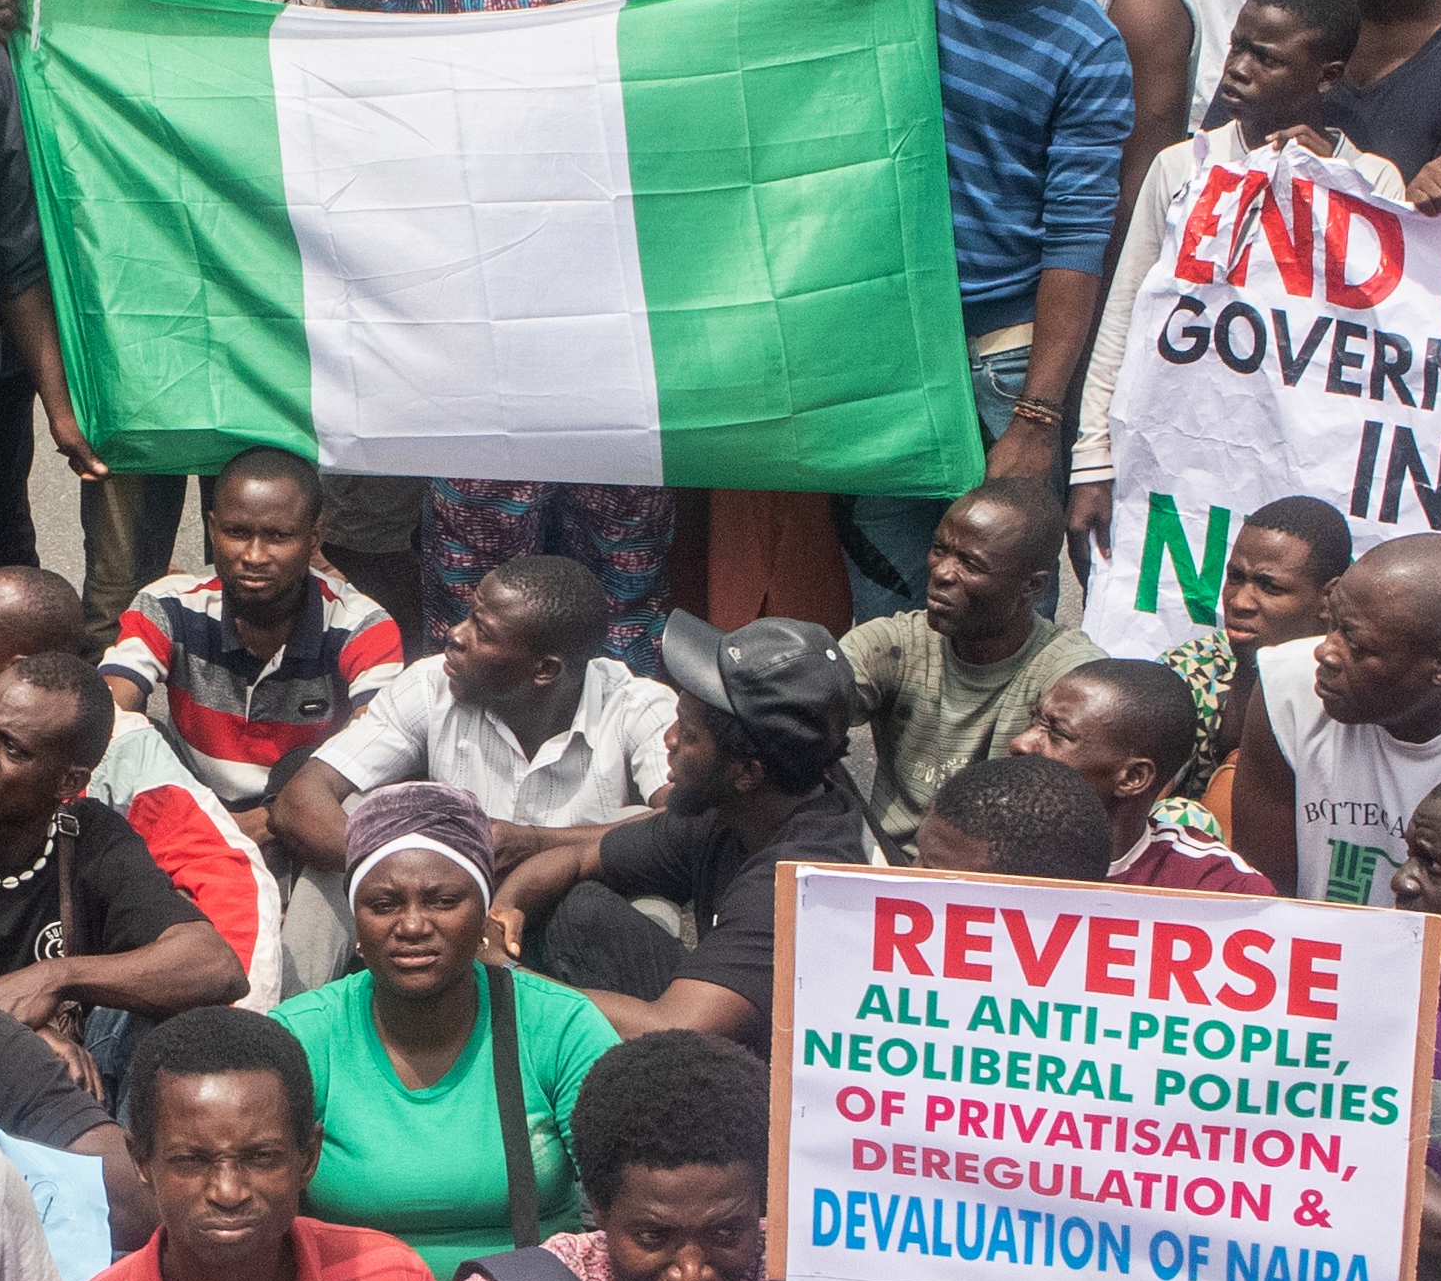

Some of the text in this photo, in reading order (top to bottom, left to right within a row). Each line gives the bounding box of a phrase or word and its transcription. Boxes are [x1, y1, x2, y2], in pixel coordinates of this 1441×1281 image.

[1174, 164, 1406, 310] END
[872, 896, 1343, 1021] REVERSE
[803, 1028, 1400, 1126] NEOLIBERAL POLICIES
[855, 983, 1351, 1076] ALL ANTI-PEOPLE,
[835, 1084, 907, 1127] OF
[925, 1094, 1359, 1182] PRIVATISATION,
[811, 1187, 1132, 1274] DEVALUATION
[852, 1137, 1334, 1229] DEREGULATION &
